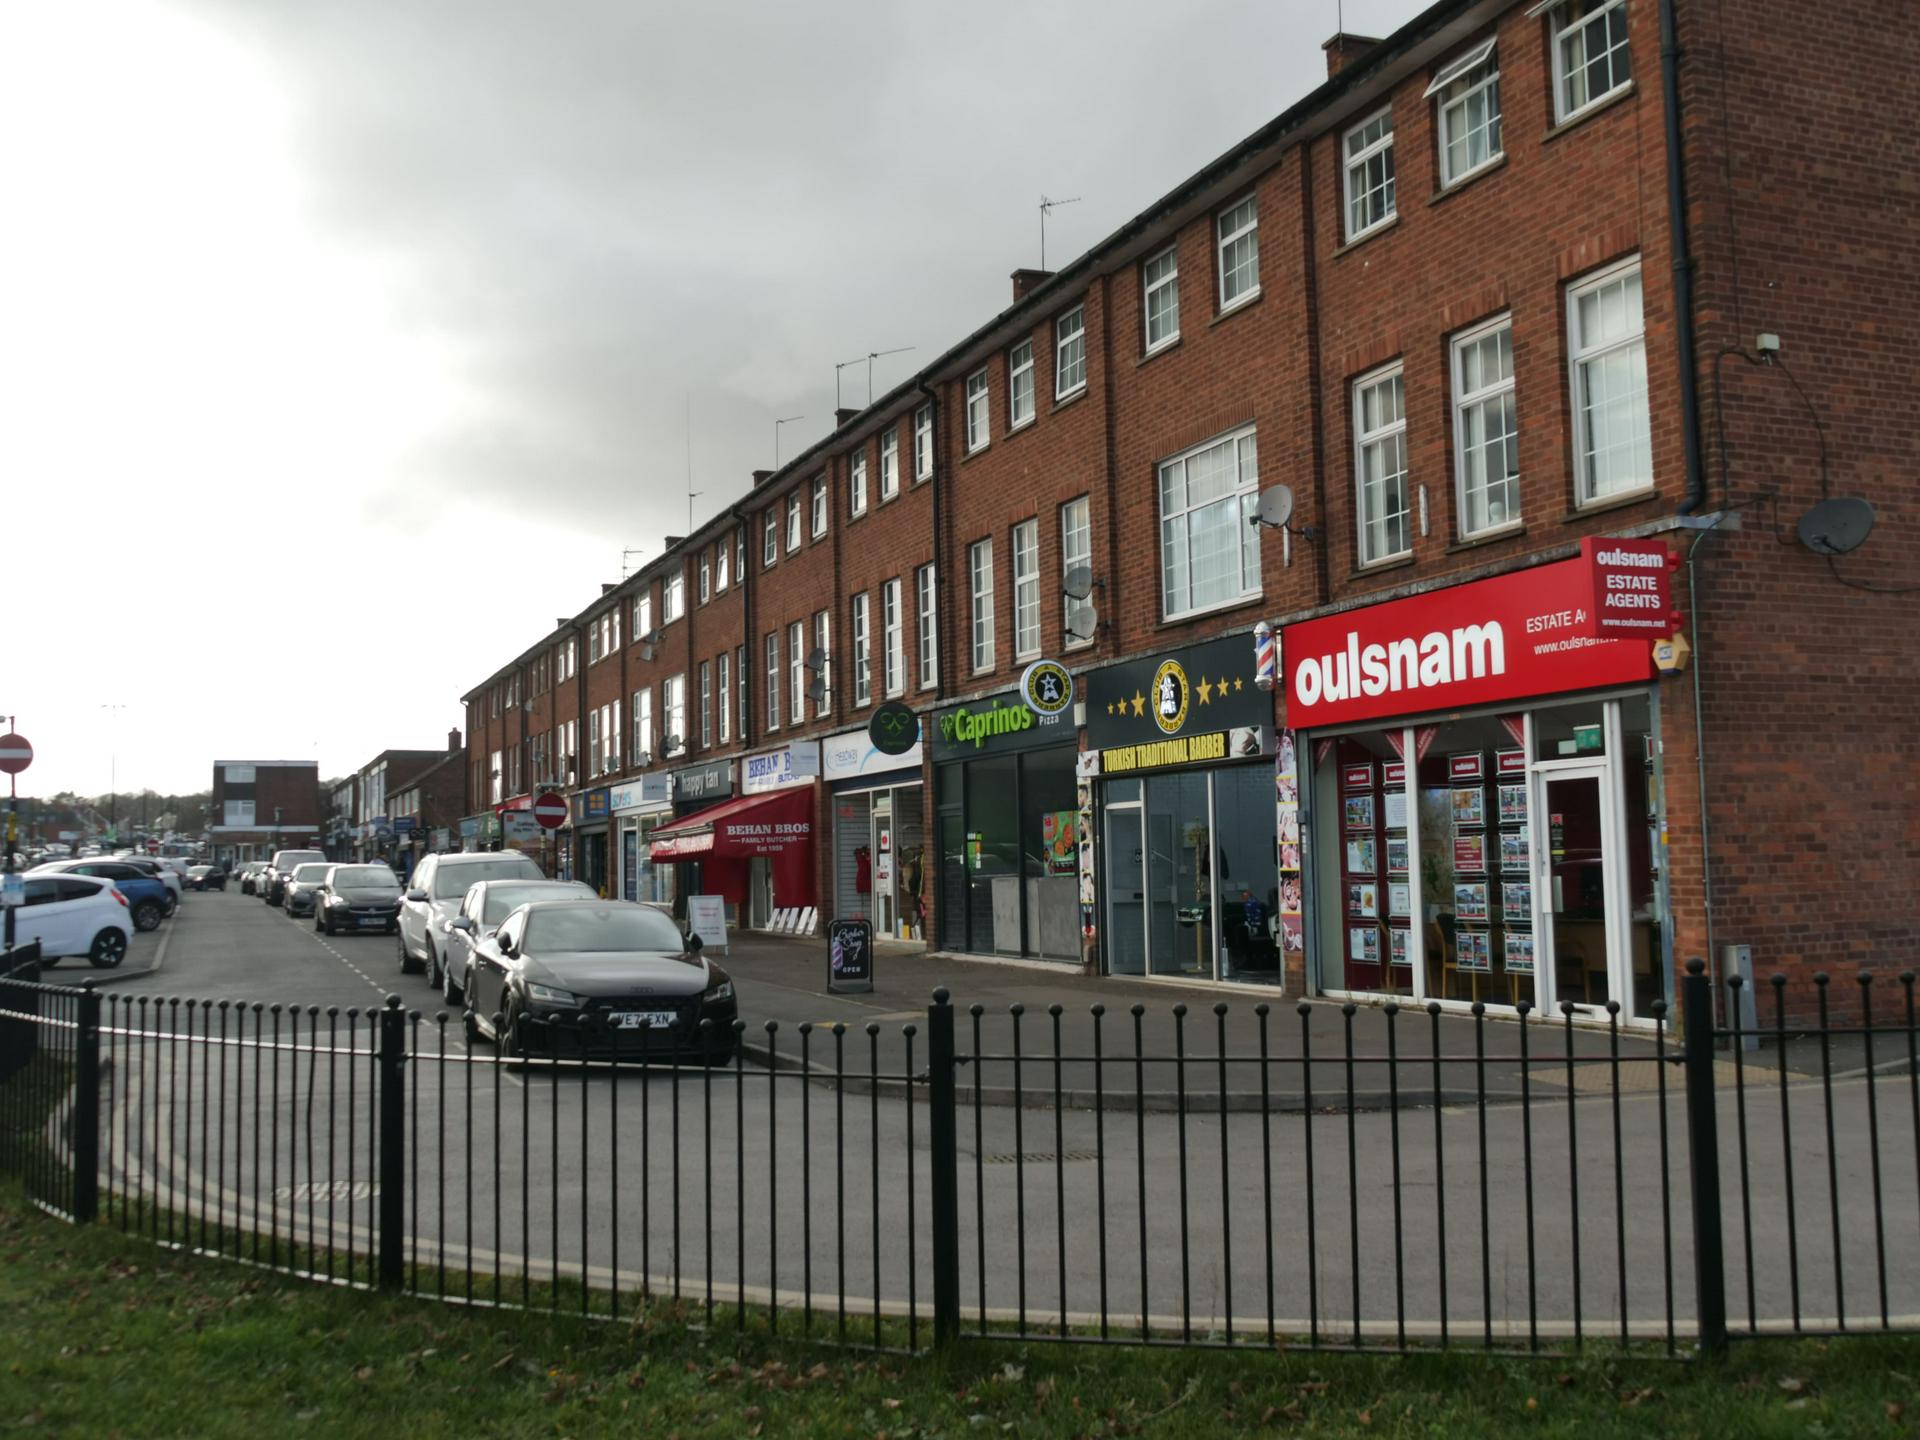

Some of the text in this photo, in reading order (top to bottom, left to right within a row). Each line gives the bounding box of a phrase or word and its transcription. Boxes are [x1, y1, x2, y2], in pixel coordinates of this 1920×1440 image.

[1597, 548, 1663, 568] oulsnam
[1606, 575, 1658, 590] ESTATE
[1605, 593, 1661, 609] AGENTS
[1526, 608, 1587, 633] ESTATE A
[1602, 618, 1666, 628] www.oulsnam.net
[1295, 620, 1506, 707] oulsnam
[955, 699, 1033, 749] Caprinos
[1039, 714, 1060, 726] Pizza
[1103, 733, 1225, 773] TURKISH TRADITIONAL BARBER
[747, 753, 778, 779] BEHAN
[681, 769, 719, 797] happy tan
[727, 823, 810, 836] BEHAN BROS
[741, 835, 798, 844] FAMILY BUTCHER
